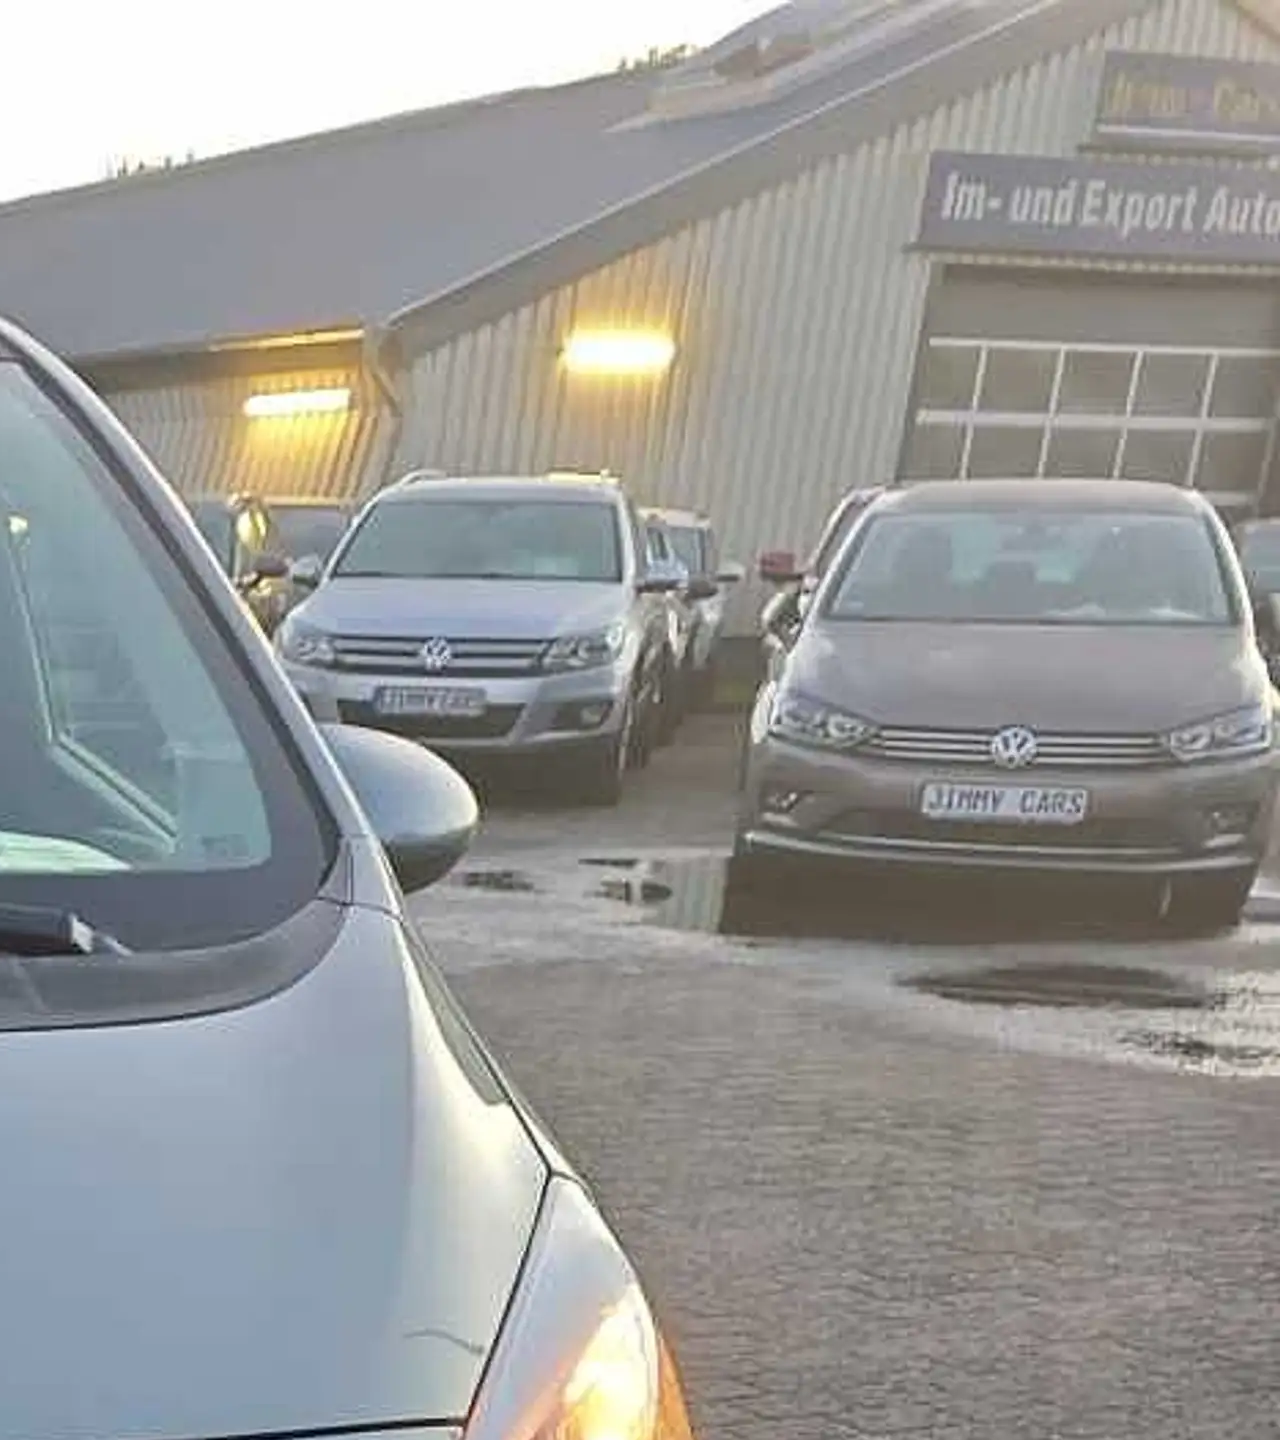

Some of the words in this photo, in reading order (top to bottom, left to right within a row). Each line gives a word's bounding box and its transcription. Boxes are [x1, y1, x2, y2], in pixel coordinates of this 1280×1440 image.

[941, 168, 1002, 221] Im-
[1008, 179, 1077, 226] und
[1077, 180, 1197, 238] Export
[929, 786, 1006, 813] JIMMY
[1020, 789, 1083, 815] CARS
